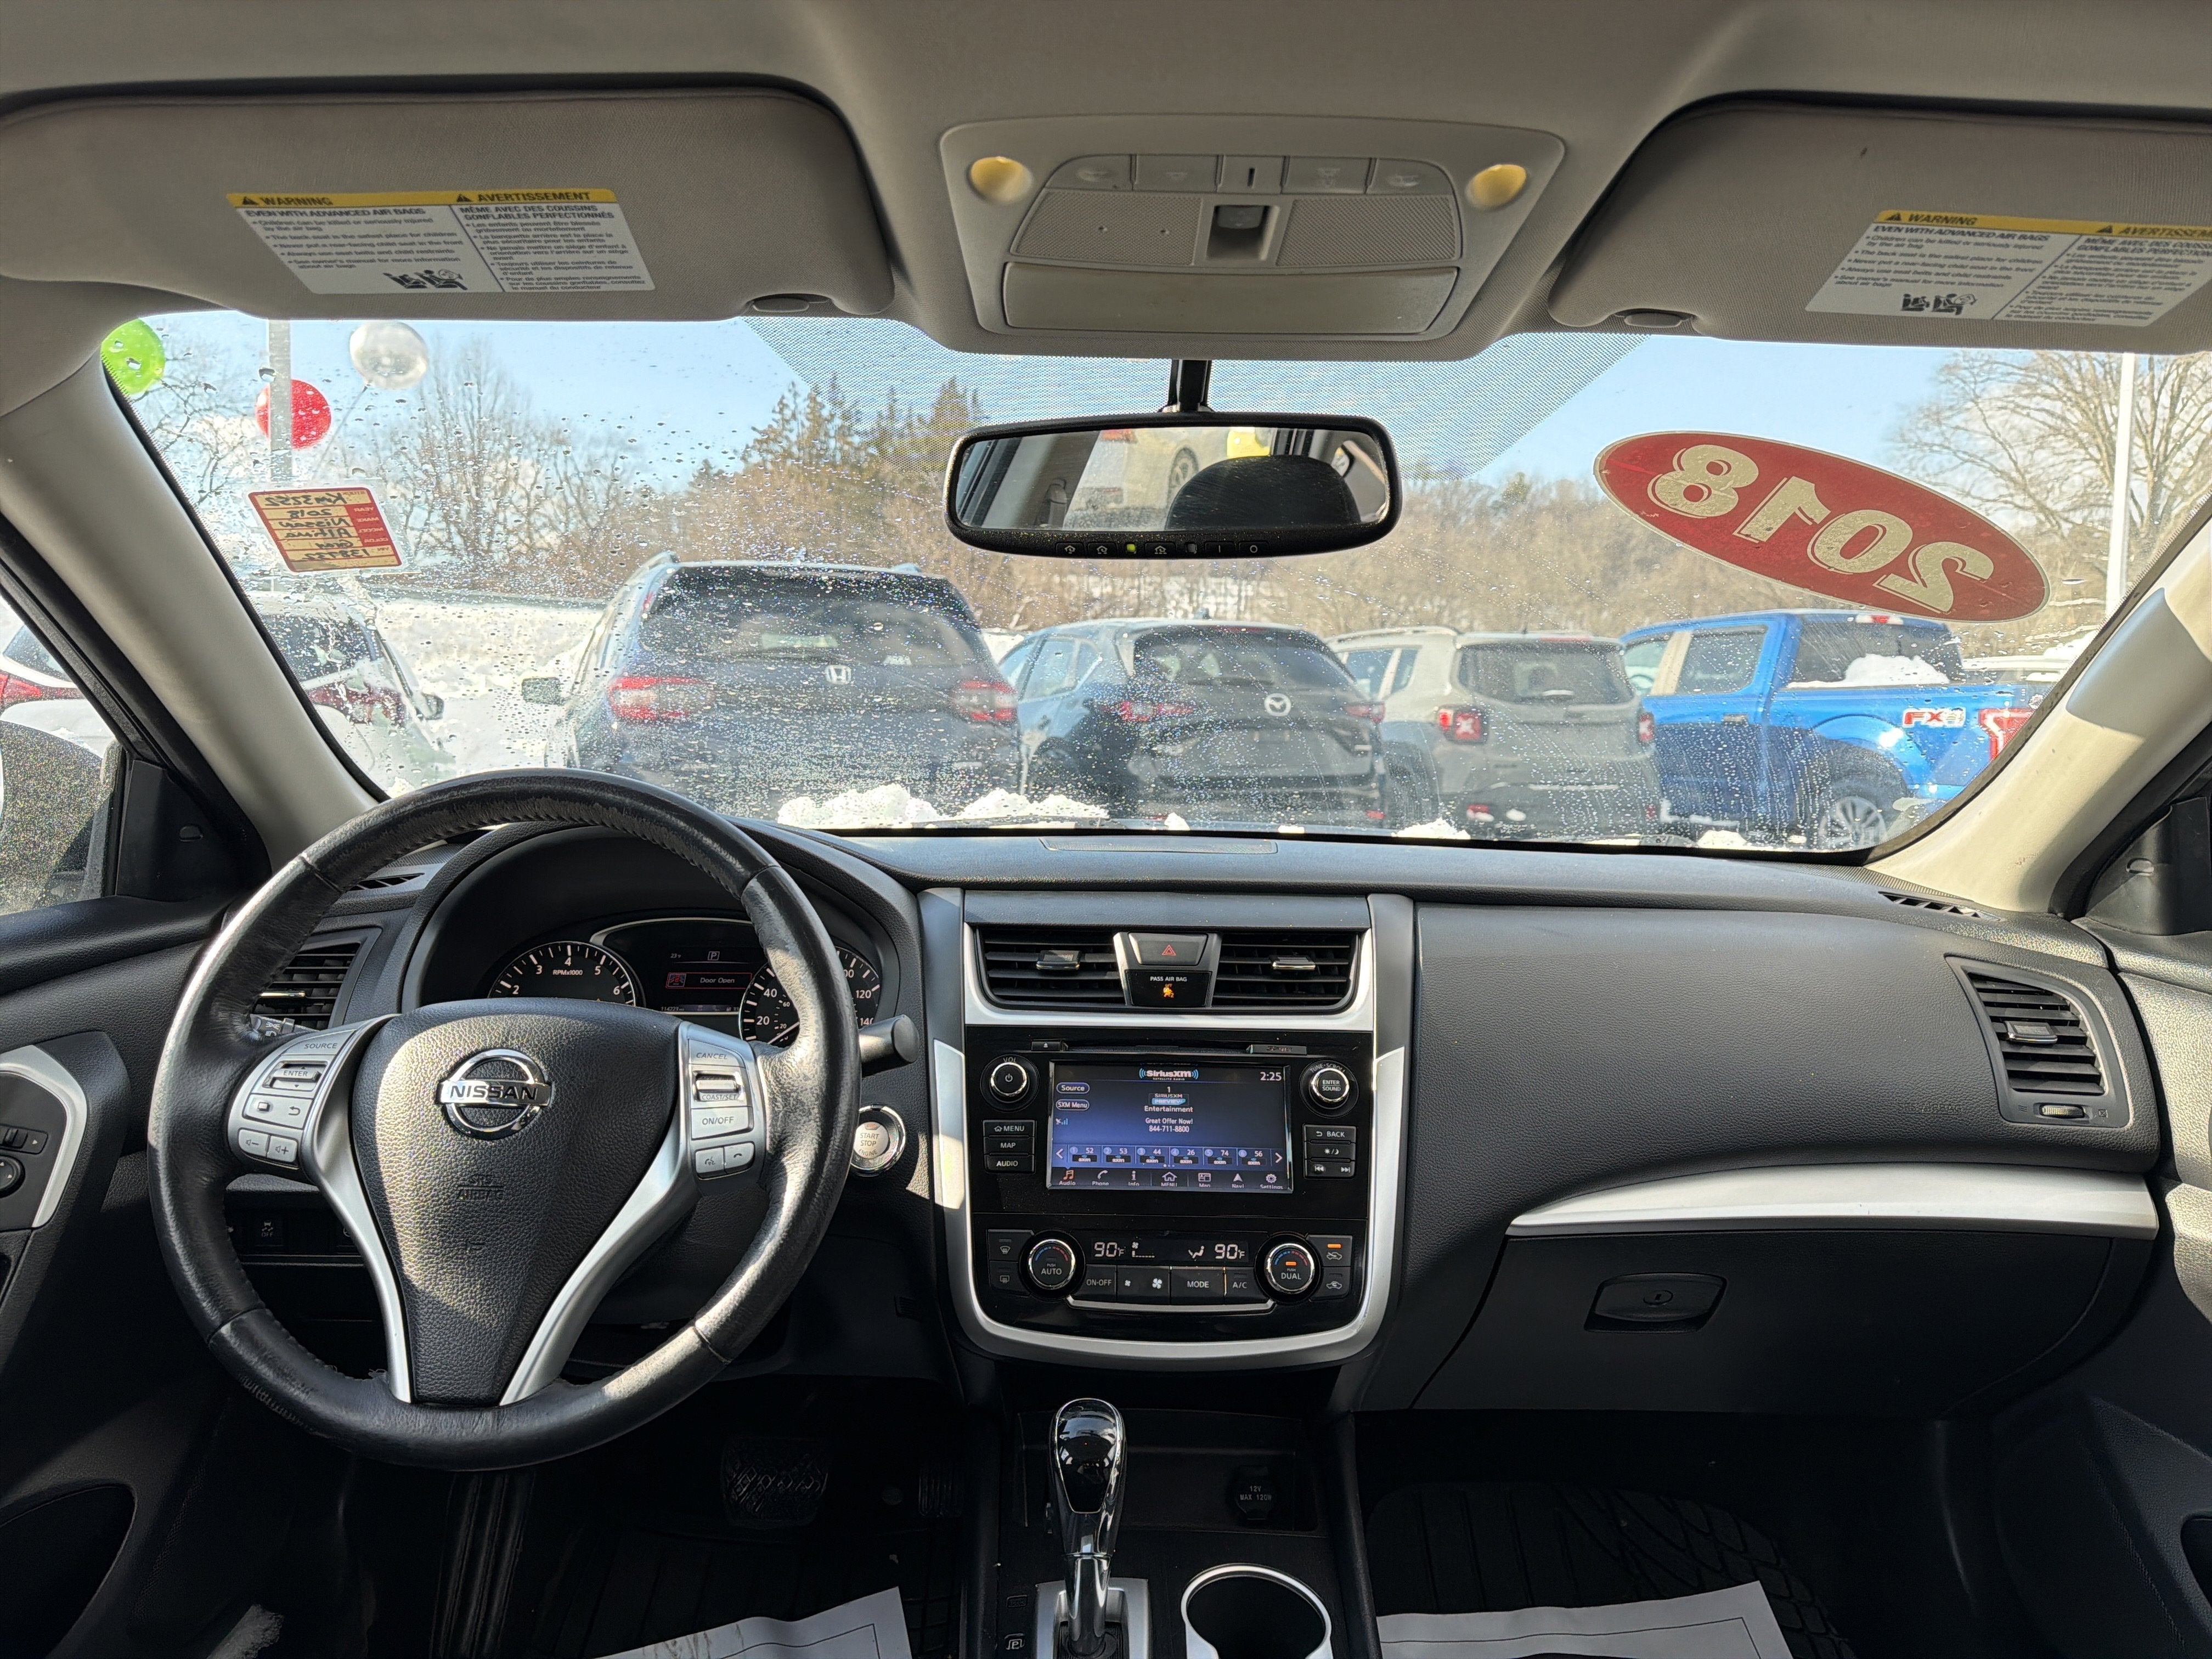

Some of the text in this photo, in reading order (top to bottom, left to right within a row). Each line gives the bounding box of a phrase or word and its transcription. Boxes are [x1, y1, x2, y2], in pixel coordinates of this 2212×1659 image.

[260, 197, 333, 205] WARNING
[478, 192, 590, 201] AVERTISSEMENT
[1908, 213, 1978, 225] WARNING
[1934, 228, 1996, 238] ADVANCED
[565, 957, 571, 966] 4
[536, 966, 542, 974] 3
[595, 966, 601, 975] 5
[512, 985, 519, 994] 2
[613, 986, 620, 995] 6
[764, 989, 777, 997] 40
[856, 990, 871, 998] 120
[757, 1016, 770, 1025] 20
[1260, 1072, 1282, 1081] 2:25
[450, 1085, 538, 1100] NISSAN
[702, 1116, 734, 1125] ON/OFF
[1232, 1281, 1247, 1290] A/C
